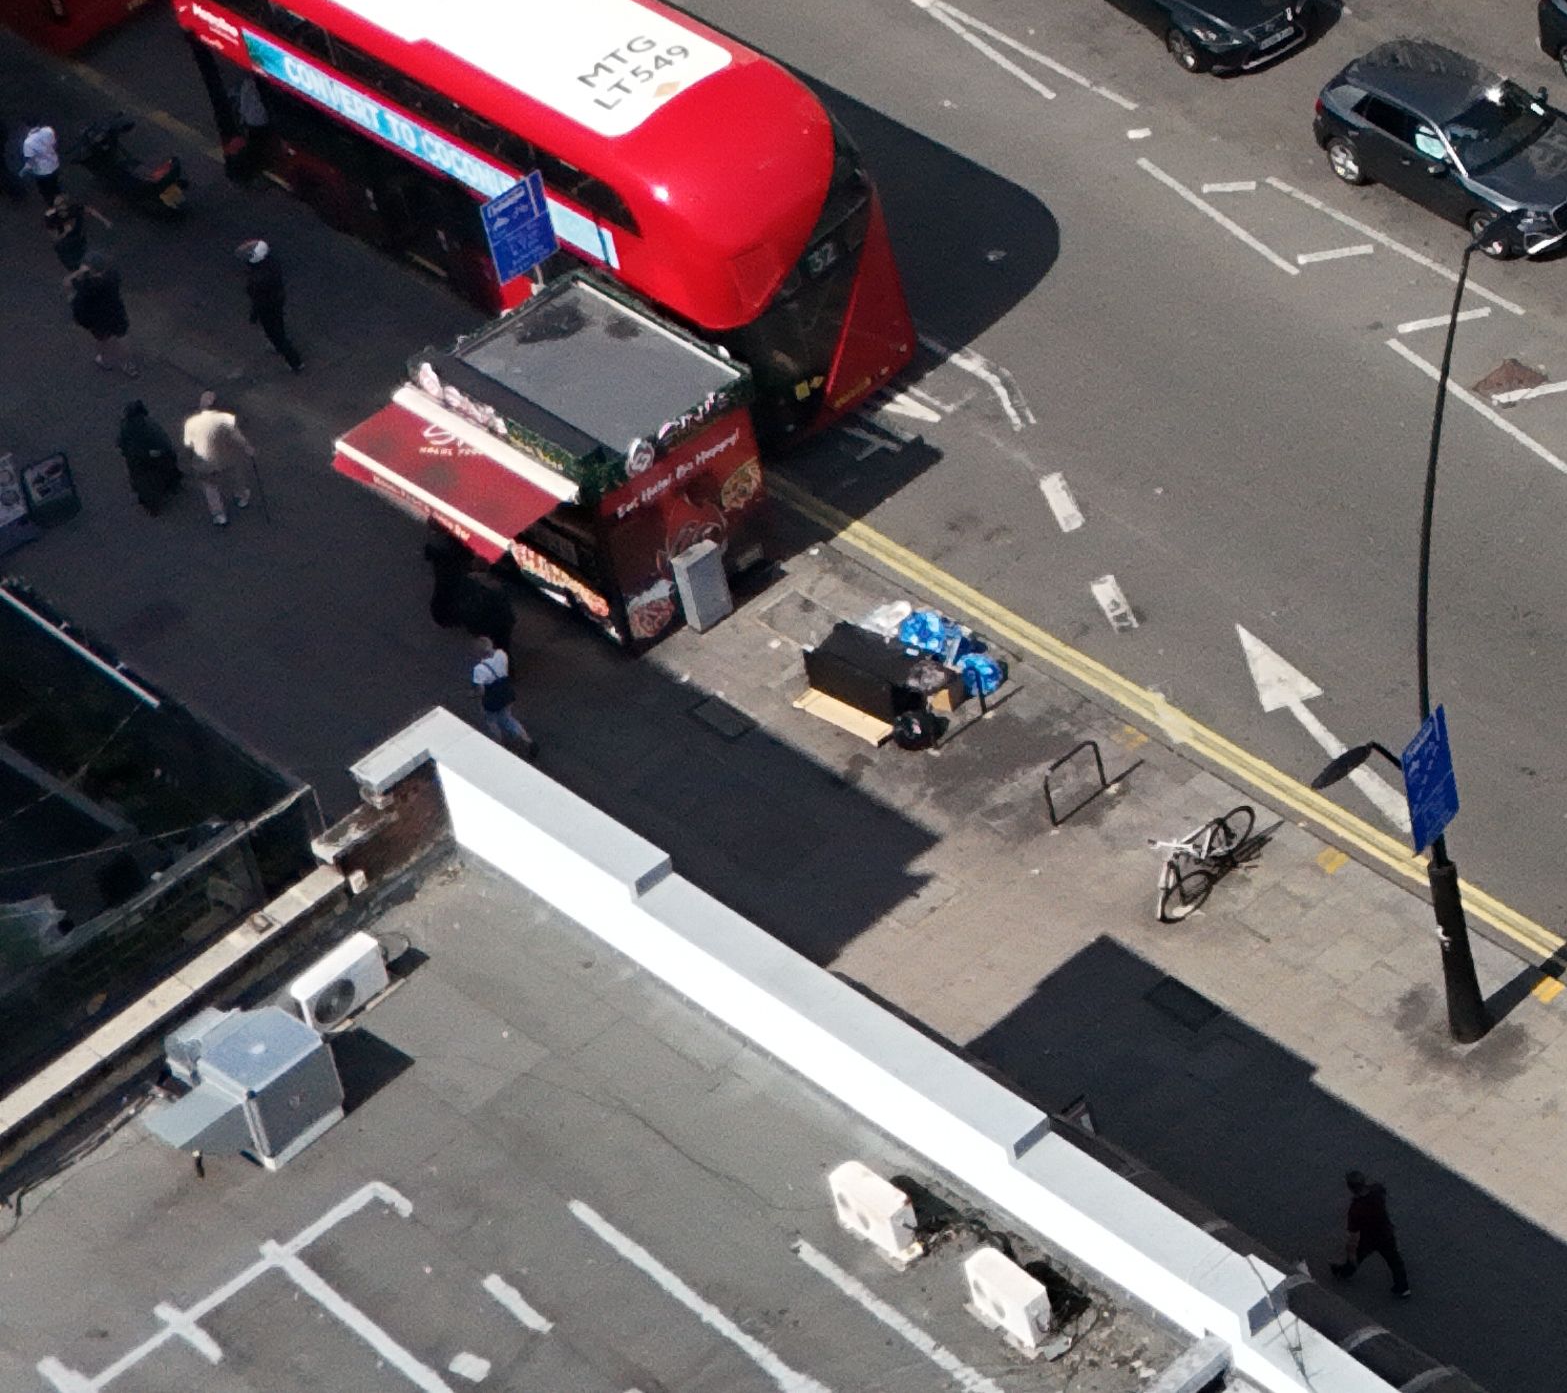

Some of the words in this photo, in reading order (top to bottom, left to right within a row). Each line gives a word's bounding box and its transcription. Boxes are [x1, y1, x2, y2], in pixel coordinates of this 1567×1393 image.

[576, 35, 657, 88] MTG
[593, 44, 690, 110] LT549
[283, 55, 381, 132] CONVERT
[383, 113, 418, 151] TO
[809, 242, 837, 274] 32
